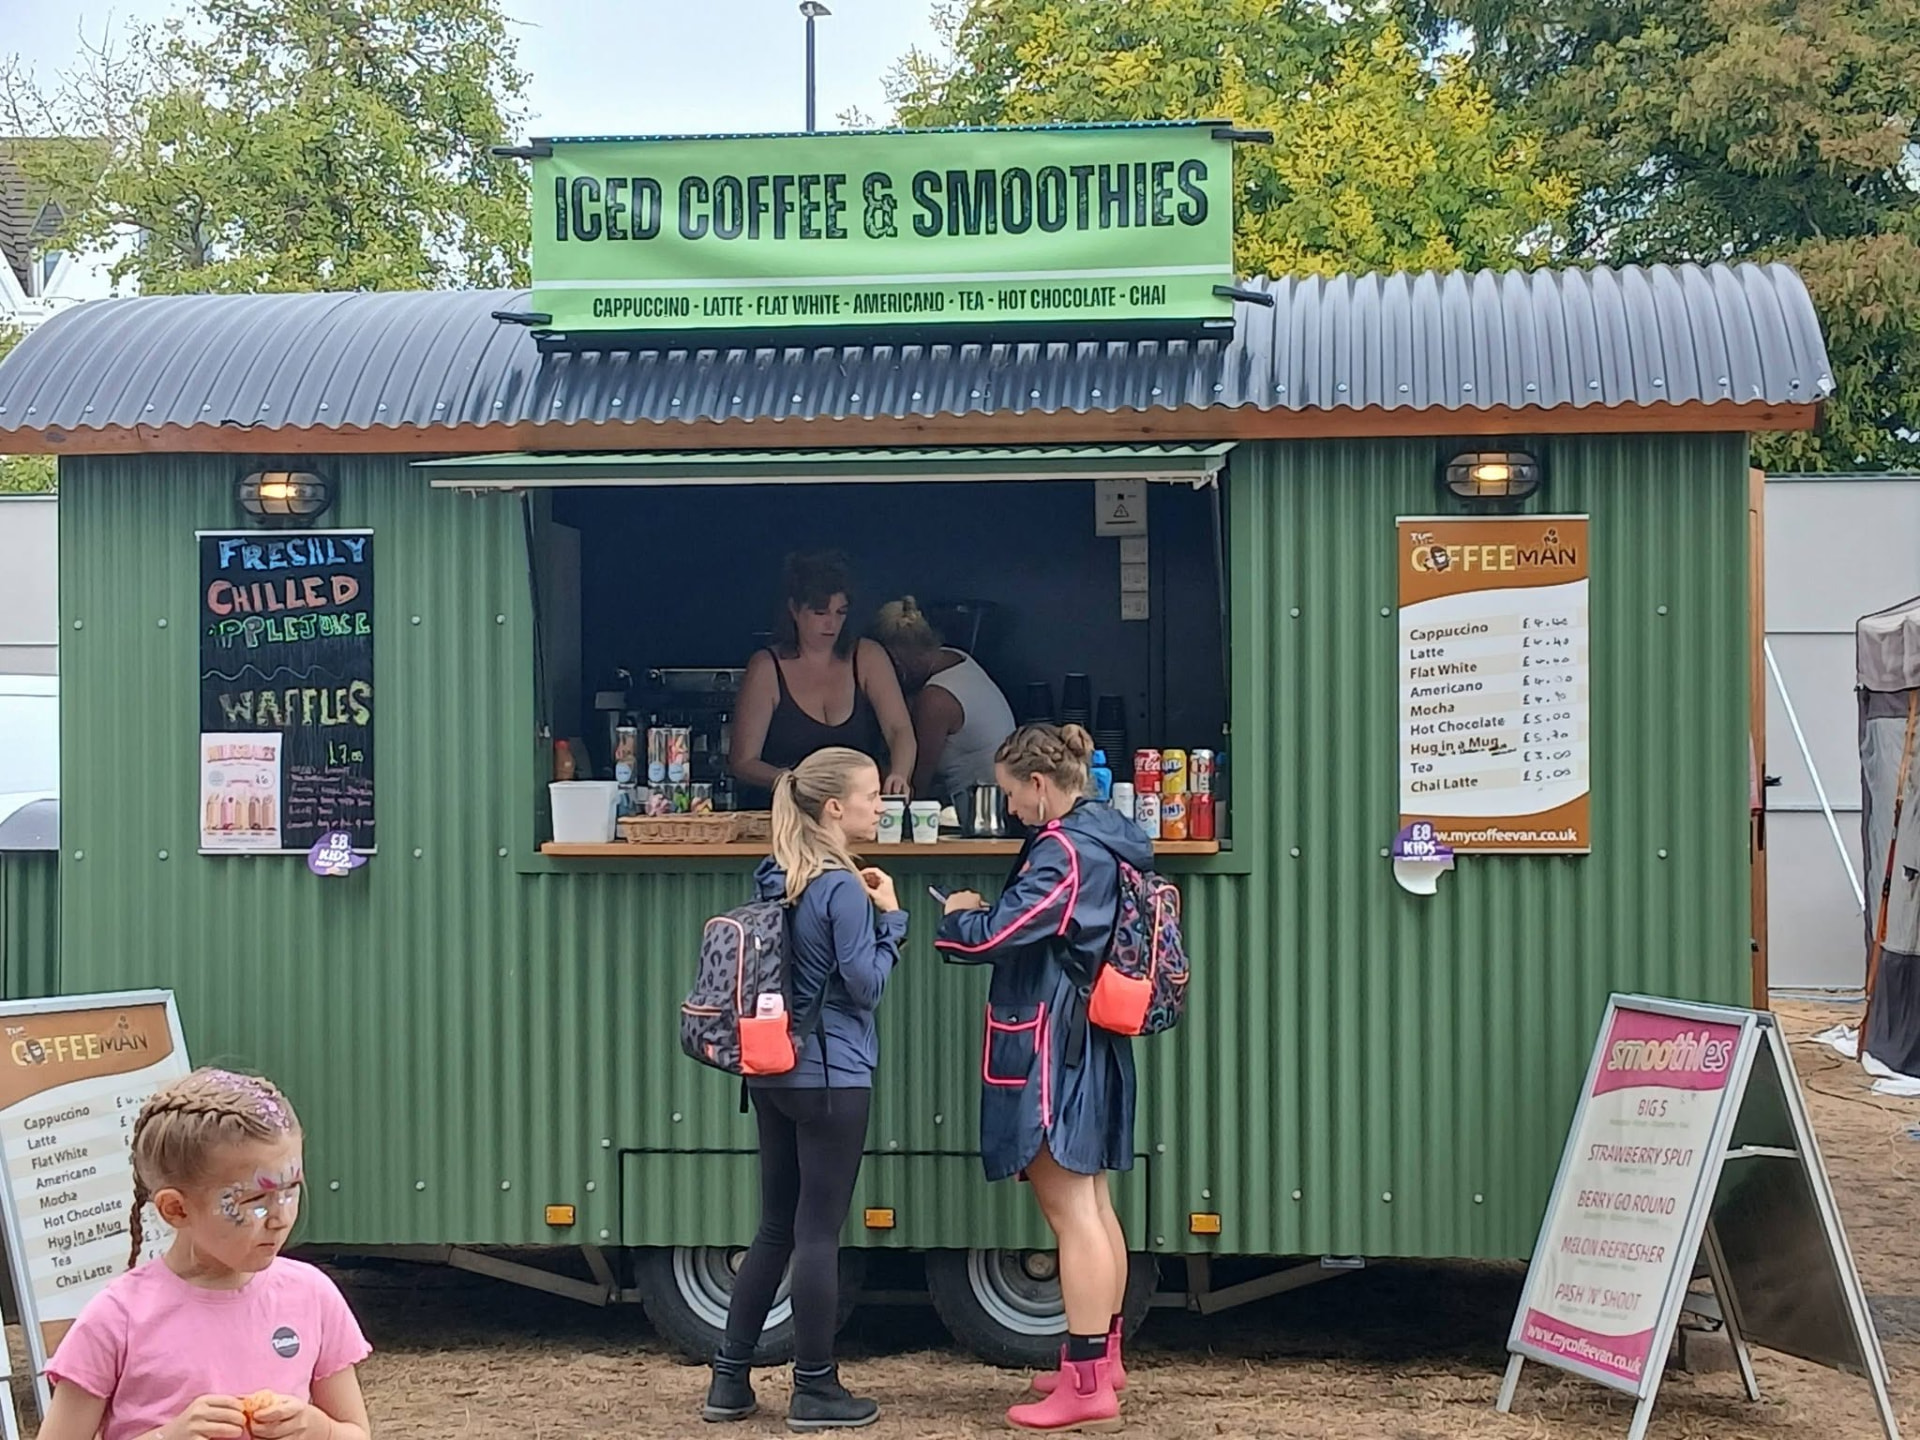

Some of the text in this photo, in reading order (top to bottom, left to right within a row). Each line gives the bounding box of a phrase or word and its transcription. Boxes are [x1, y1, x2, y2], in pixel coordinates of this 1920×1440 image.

[555, 159, 1209, 242] ICED COFFEE & SMOOTHIES
[593, 284, 1166, 318] CAPPUCCINO LATTE FLAT WHITE AMERICANO TEA HOT CHOCOLATE CHAI
[207, 575, 360, 616] CHILLED
[1409, 622, 1489, 642] Cappuccino
[1410, 647, 1445, 660] Latte
[1410, 662, 1478, 679] Flat White
[1410, 682, 1483, 698] Americano
[219, 680, 373, 726] WAFFLES
[1410, 701, 1455, 717] Mocha
[1410, 716, 1505, 736] Hot Chocolate
[1410, 736, 1499, 756] Hug in a Mug
[1410, 762, 1433, 773] Tea
[1410, 777, 1478, 793] Chai Latte
[1412, 823, 1432, 841] £8
[318, 848, 351, 862] KIDS
[1403, 841, 1436, 856] KIDS
[1607, 1030, 1733, 1073] smoothies
[24, 1106, 90, 1131] Cappuccino
[1636, 1099, 1659, 1118] BIG
[27, 1135, 57, 1150] Latte
[31, 1147, 88, 1170] Flat White
[1588, 1144, 1693, 1168] STRAWBERRY SPLIT
[36, 1165, 97, 1189] Americano
[40, 1190, 78, 1209] Mocha
[1577, 1190, 1676, 1216] BERRY GO ROUND
[43, 1216, 65, 1229] Hot
[67, 1199, 122, 1223] Chocolate
[48, 1220, 122, 1250] Hug in a Mug
[1560, 1235, 1665, 1263] MELON REFRESHER
[51, 1256, 72, 1268] Tea
[56, 1264, 113, 1289] Chai Latte
[1555, 1282, 1586, 1302] PASH
[1600, 1289, 1643, 1311] SHOOT
[1526, 1323, 1642, 1376] www.mycoffeevan.co.uk
